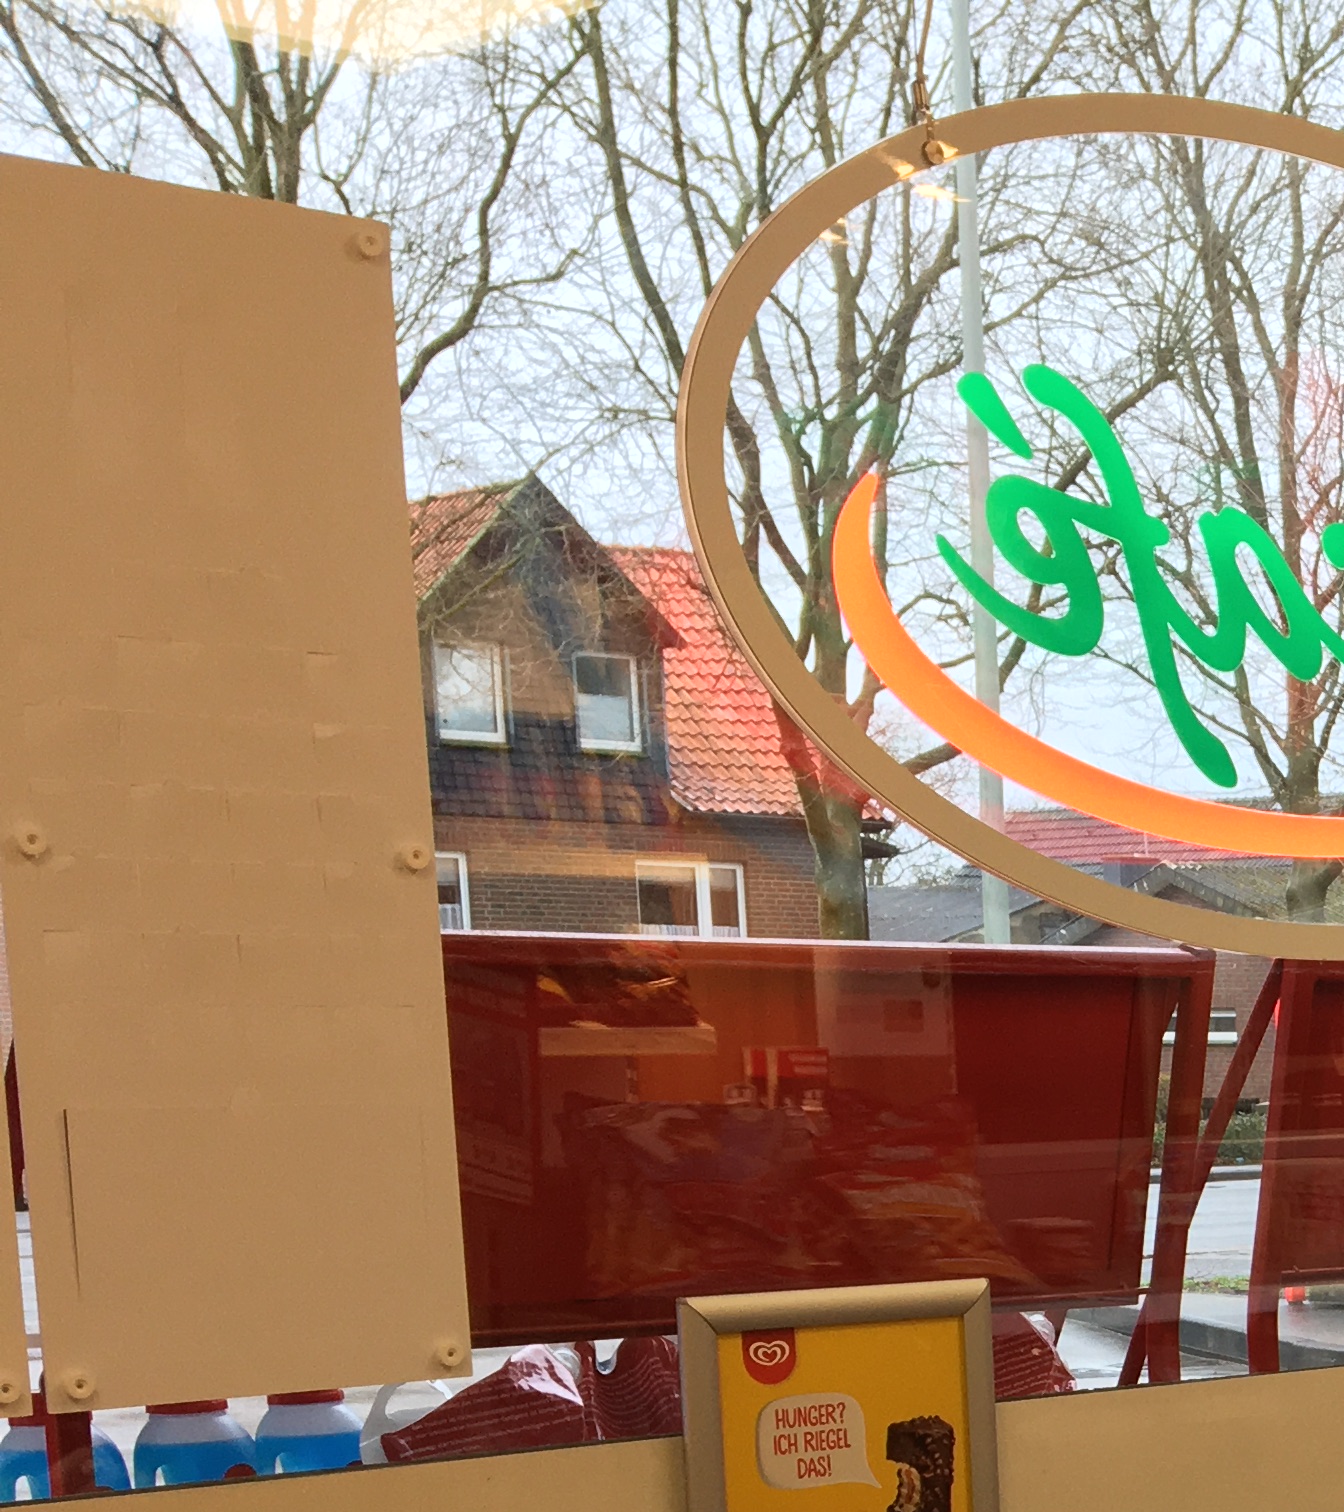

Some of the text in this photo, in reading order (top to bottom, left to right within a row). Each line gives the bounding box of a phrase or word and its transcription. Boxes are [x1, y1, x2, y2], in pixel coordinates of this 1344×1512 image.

[773, 1402, 847, 1430] HUNGER?
[773, 1426, 852, 1457] ICH RIEGEL
[796, 1454, 834, 1480] DAS!
